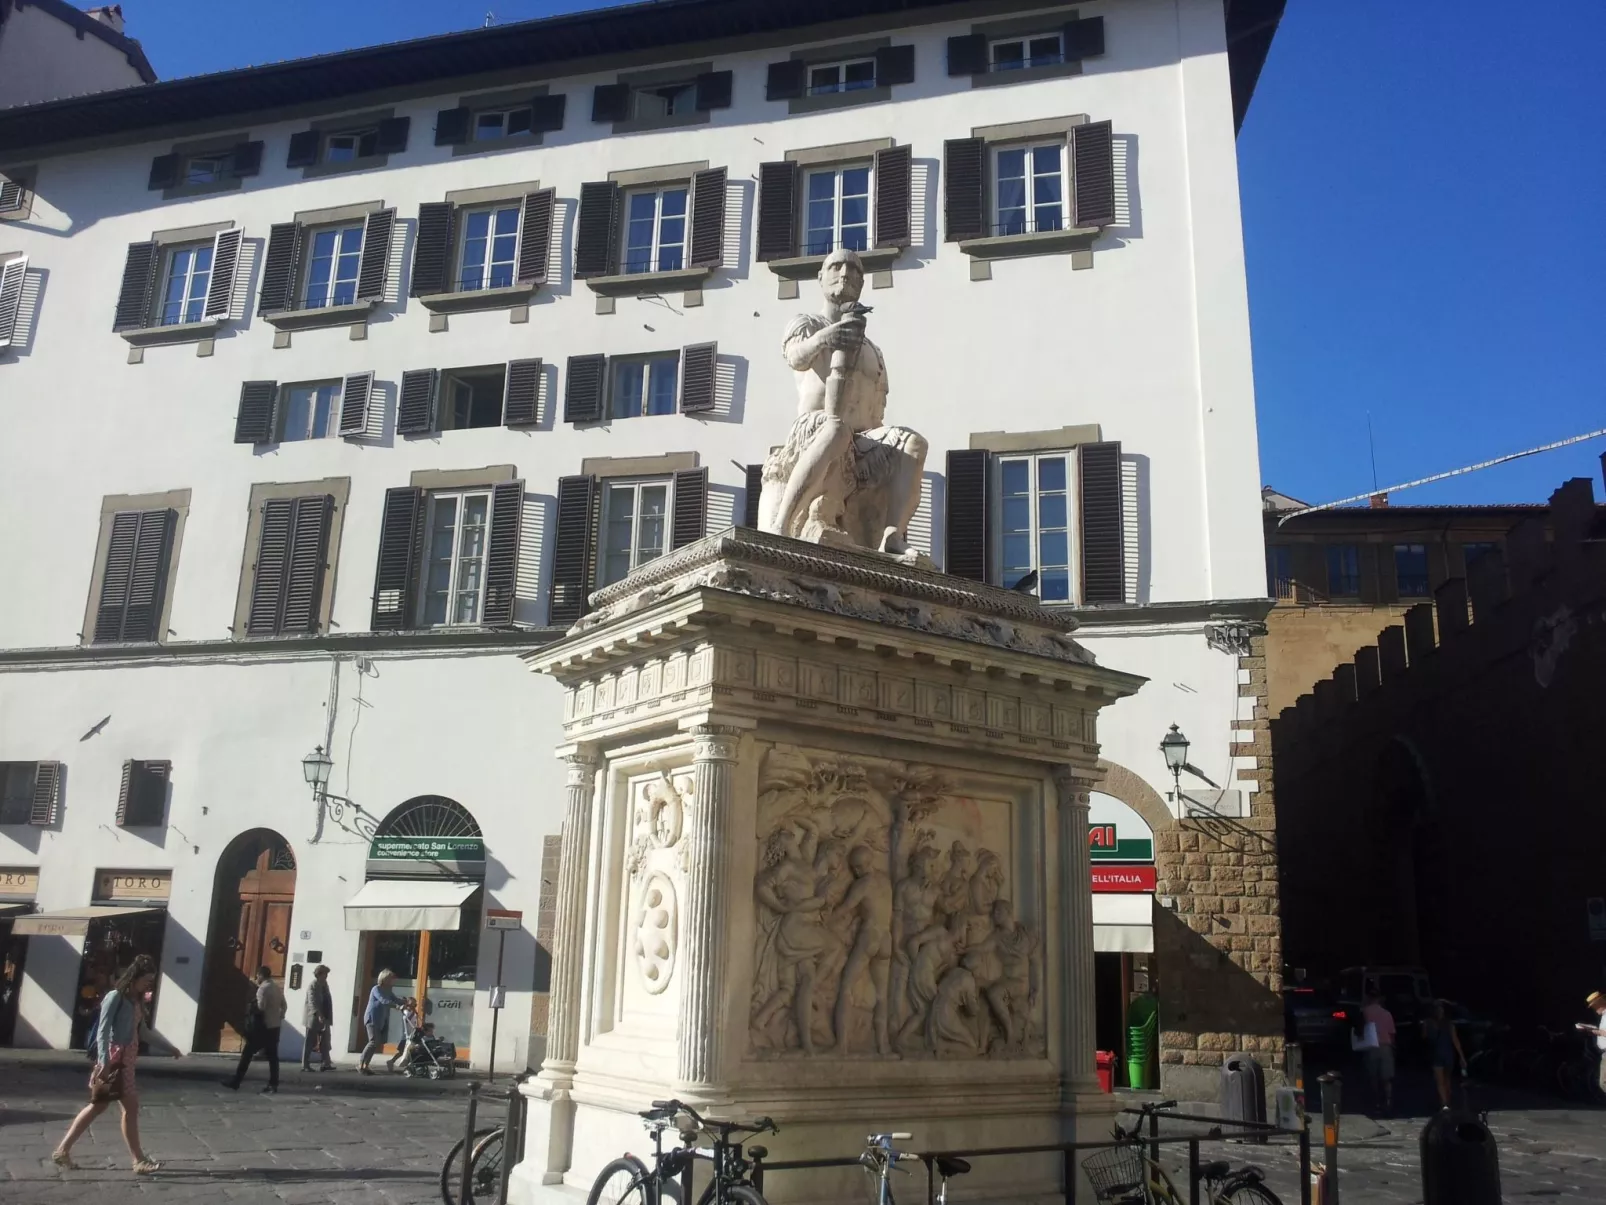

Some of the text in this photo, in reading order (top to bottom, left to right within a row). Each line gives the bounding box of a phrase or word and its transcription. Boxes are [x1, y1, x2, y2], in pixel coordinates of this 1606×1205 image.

[431, 841, 446, 850] San
[447, 841, 479, 851] Lorenzo
[0, 873, 26, 885] RO
[113, 876, 161, 889] TORO
